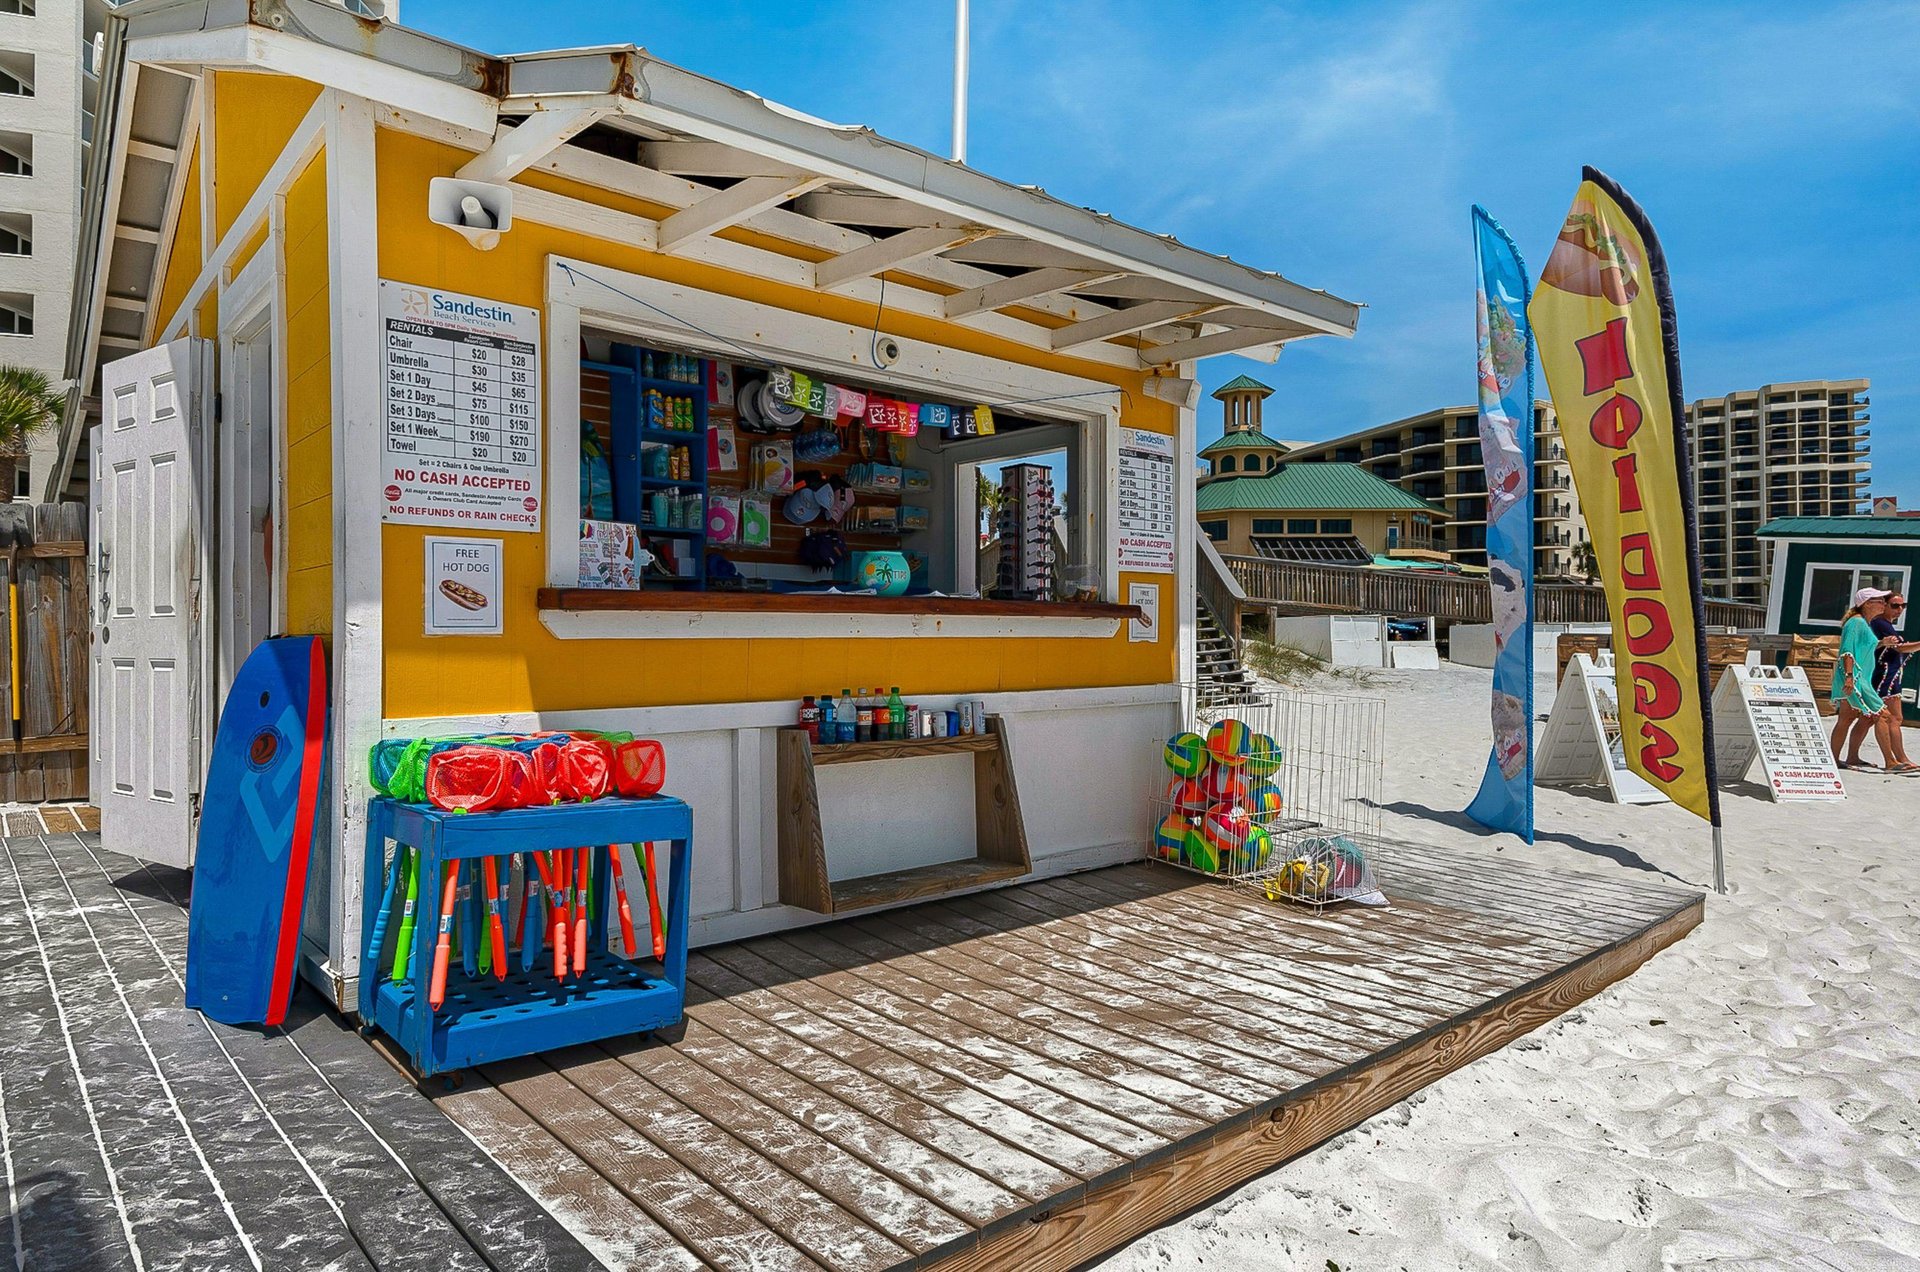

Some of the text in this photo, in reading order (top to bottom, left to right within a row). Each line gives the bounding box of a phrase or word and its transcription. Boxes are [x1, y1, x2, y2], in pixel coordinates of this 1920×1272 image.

[432, 294, 512, 322] Sandestin
[405, 315, 421, 323] OPEN
[434, 310, 496, 328] Beach Services
[390, 321, 433, 336] RENTALS
[389, 335, 526, 367] Chair $20 $28
[390, 352, 526, 383] Umbrella $30 $35
[390, 369, 526, 399] Set 1 Day $45 $65
[390, 386, 404, 398] Set
[407, 389, 413, 399] 2
[415, 390, 436, 406] Days
[471, 398, 487, 410] $75
[509, 403, 529, 415] $115
[390, 404, 404, 416] Set
[407, 406, 413, 416] 3
[415, 407, 436, 422] Days
[470, 414, 490, 426] $100
[509, 419, 529, 431] $150
[390, 421, 404, 433] Set
[407, 423, 412, 433] 1
[415, 423, 439, 437] Week
[470, 430, 490, 443] $190
[509, 435, 529, 447] $270
[1135, 431, 1166, 446] Sandestin
[390, 438, 527, 463] Towel $20 $20
[418, 459, 429, 467] Set
[442, 461, 462, 470] Chairs
[470, 464, 482, 472] One
[483, 464, 510, 474] Umbrella
[394, 469, 531, 492] NO CASH ACCEPTED
[390, 506, 537, 523] NO REFUNDS OR RAIN CHECKS
[1120, 538, 1172, 550] NO CASH ACCEPTED
[456, 549, 480, 558] FREE
[443, 562, 490, 573] HOT DOG
[1763, 685, 1800, 695] Sandestin
